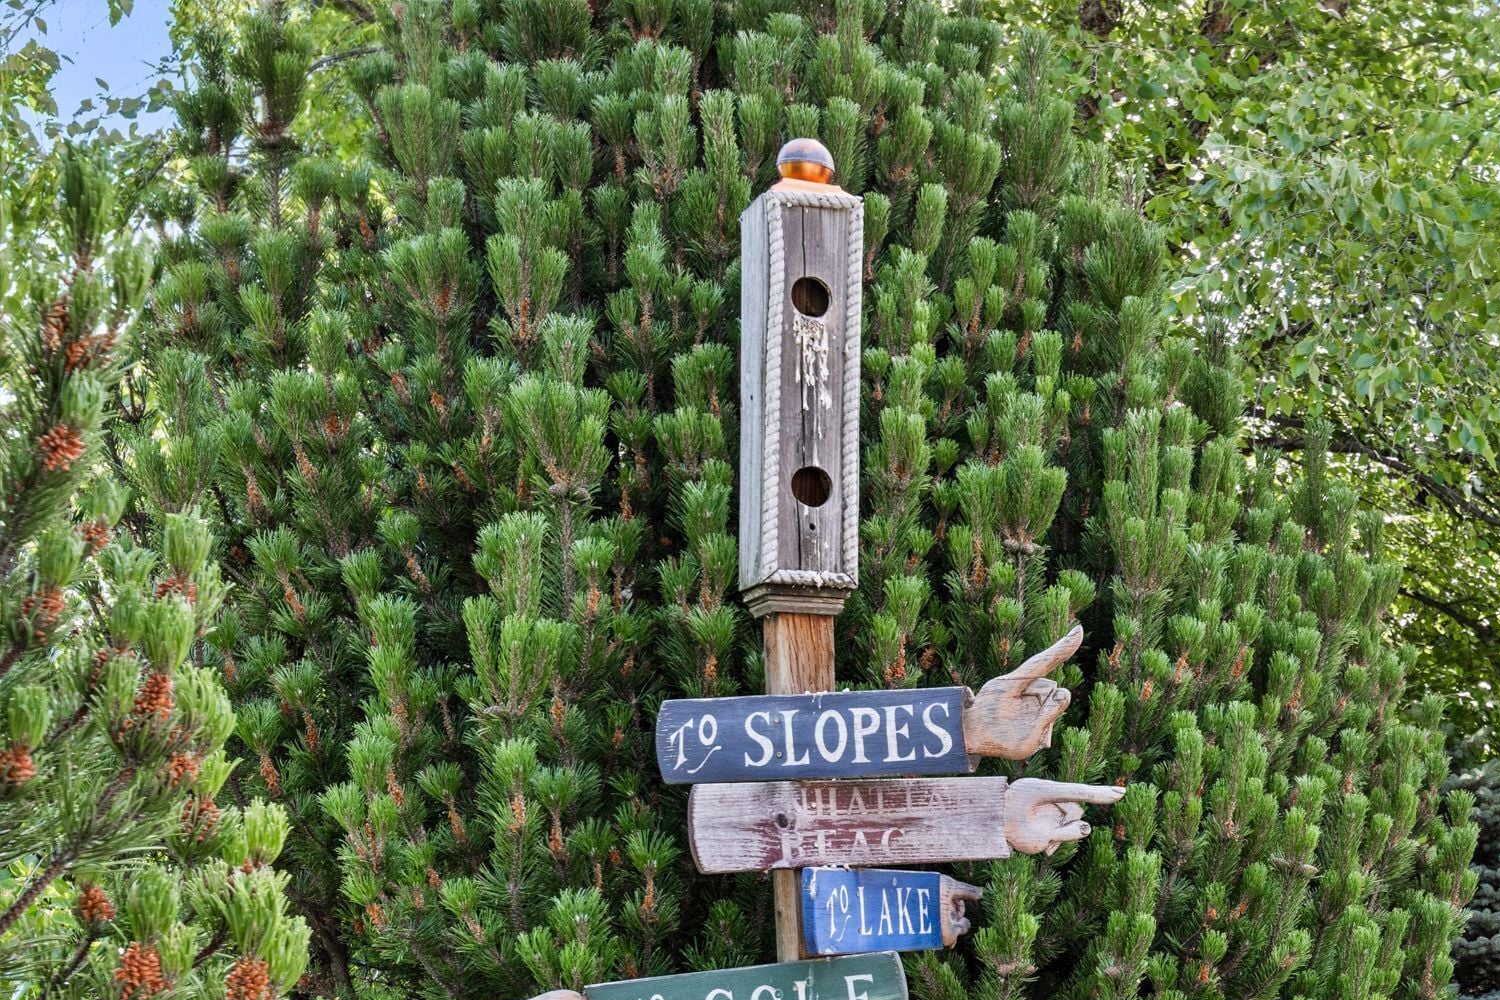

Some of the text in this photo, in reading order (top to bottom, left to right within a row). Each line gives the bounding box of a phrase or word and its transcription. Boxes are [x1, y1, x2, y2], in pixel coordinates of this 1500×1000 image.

[669, 702, 952, 772] TO SLOPES
[826, 884, 933, 940] TO LAKE
